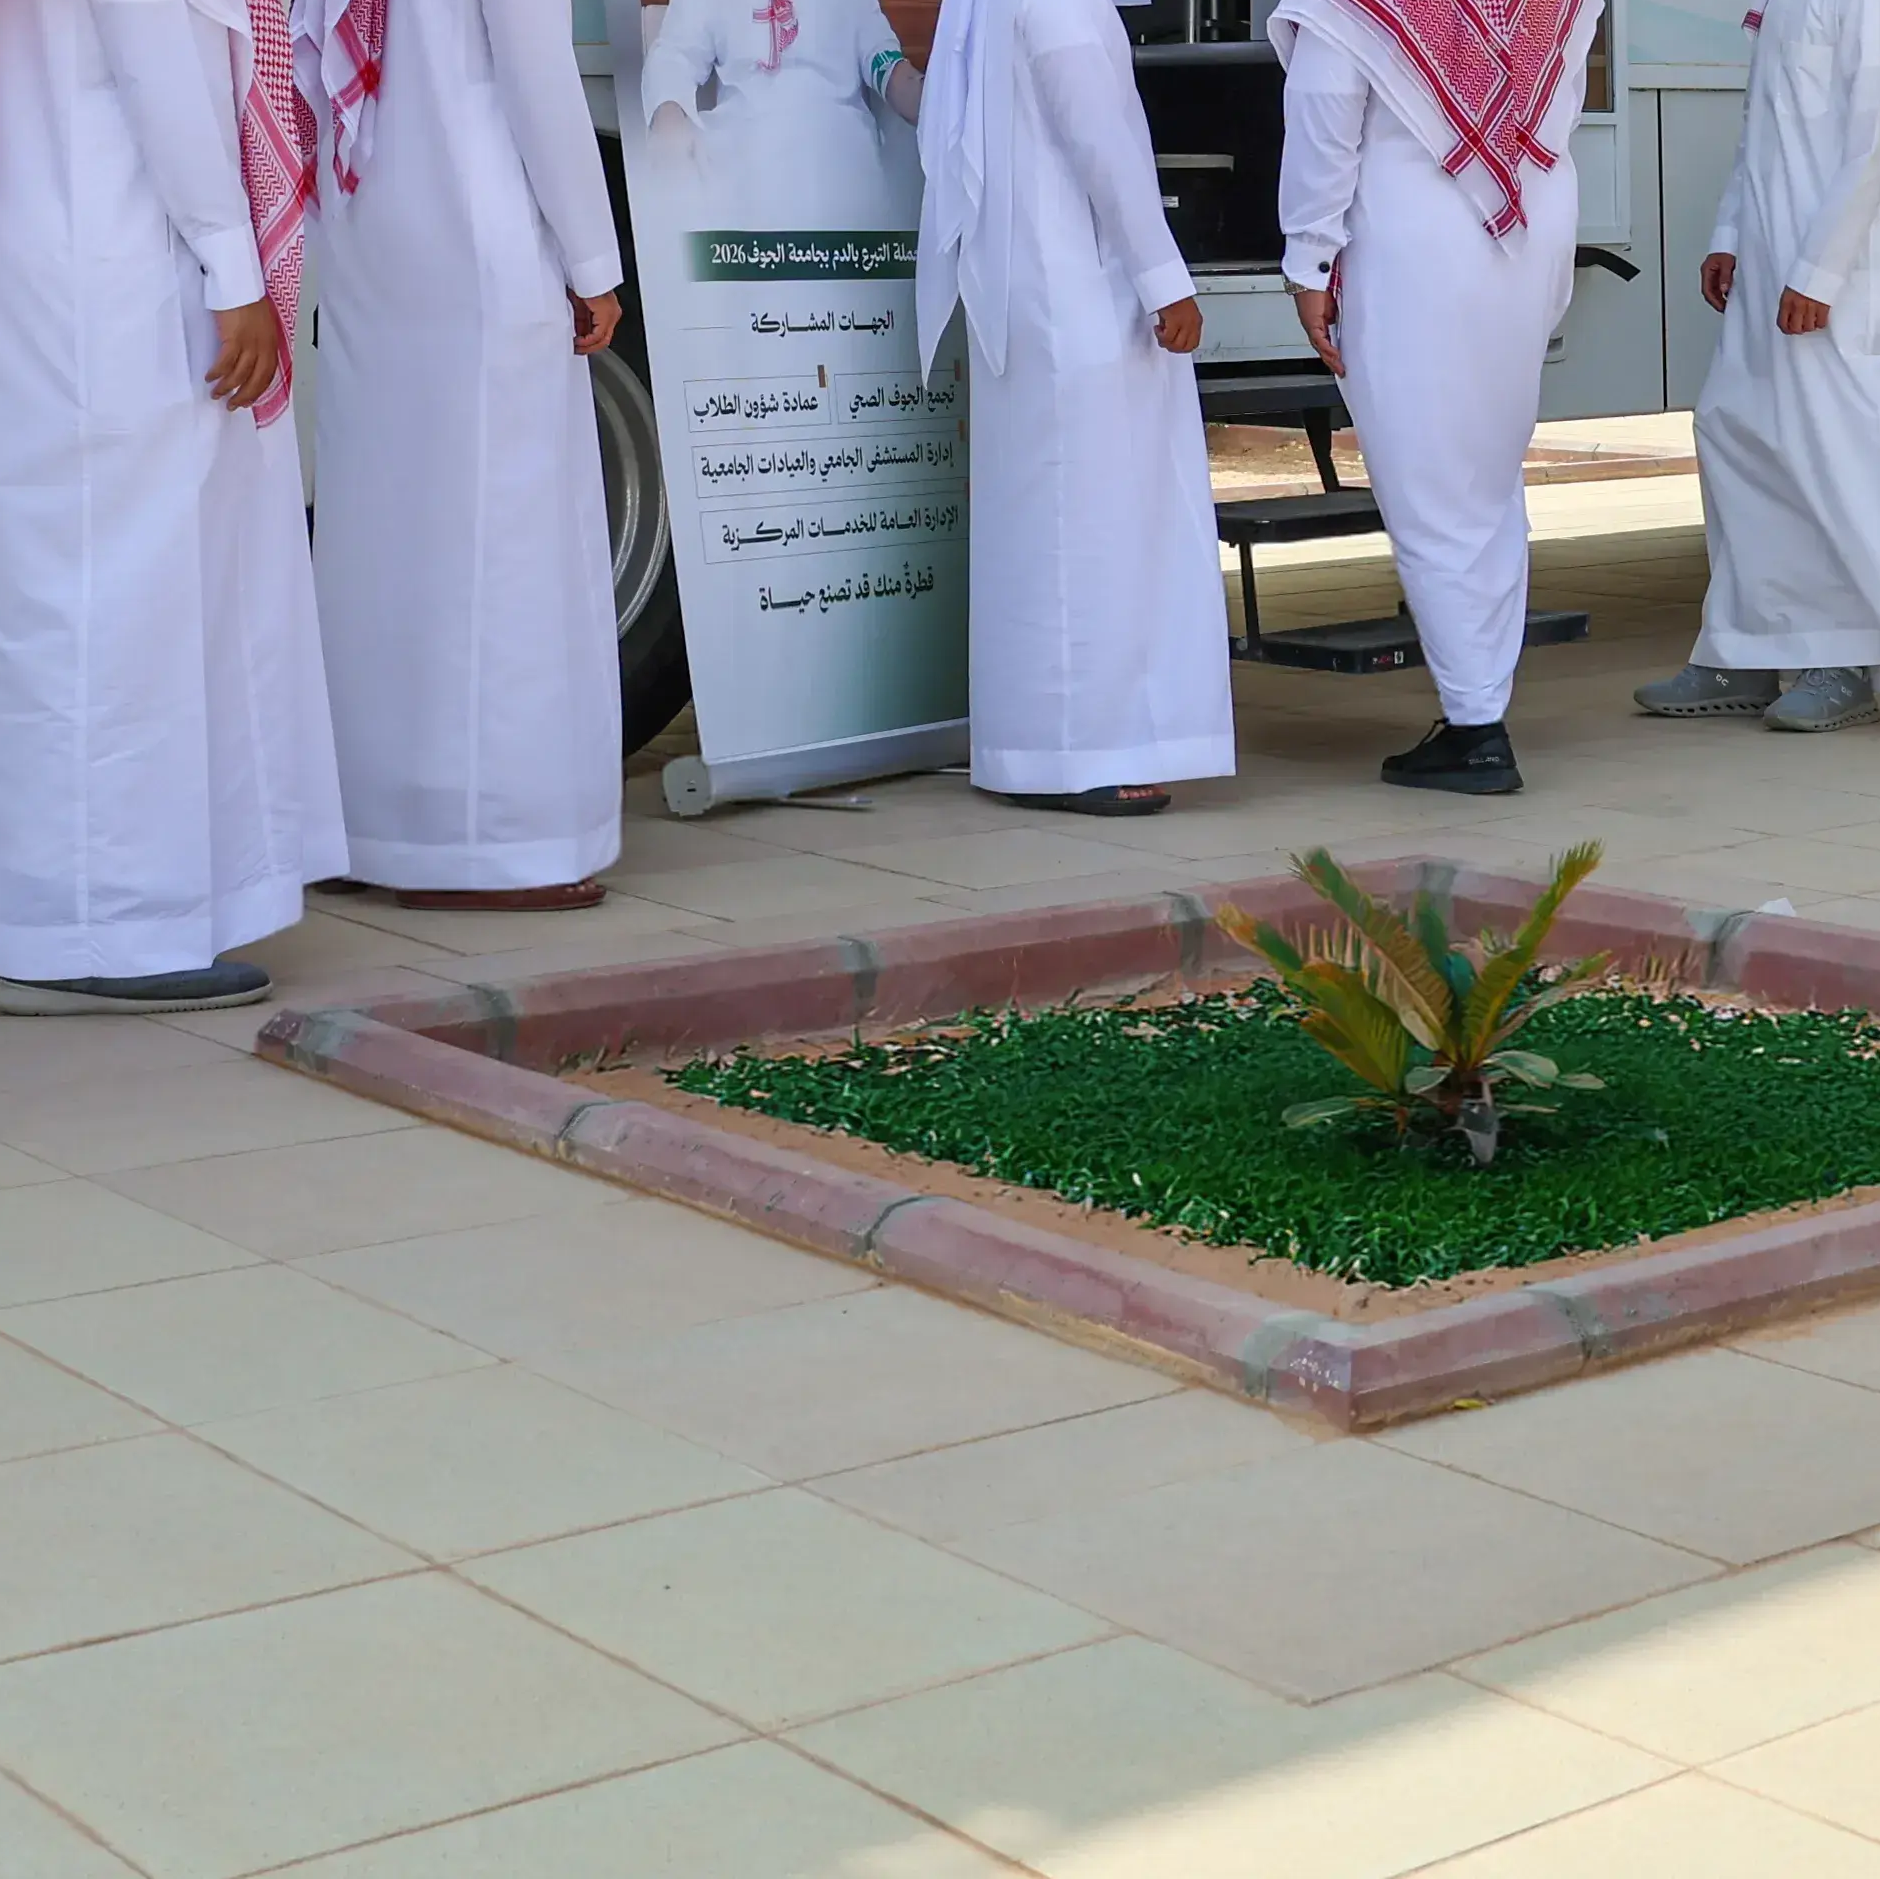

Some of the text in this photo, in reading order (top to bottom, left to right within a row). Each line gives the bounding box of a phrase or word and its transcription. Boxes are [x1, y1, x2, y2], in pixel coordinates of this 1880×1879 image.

[710, 243, 746, 264] 2026
[747, 240, 785, 270] الجوف
[788, 242, 829, 269] بجامعة
[832, 242, 859, 271] بالدم
[861, 242, 890, 272] التبرع
[750, 309, 894, 338] الجهات المشاركة
[693, 390, 819, 424] عمادة شؤون الطلاب
[849, 383, 955, 419] تجمع الجوف الصحي
[701, 441, 955, 484] إدارة المستشفى الجامعي والعيادات الجامعية
[807, 510, 877, 539] للخدمات
[880, 507, 921, 531] العامة
[722, 517, 805, 551] المركزية
[758, 586, 816, 614] حياة
[818, 578, 852, 613] تصنع
[855, 573, 870, 600] قد
[873, 573, 902, 598] منك
